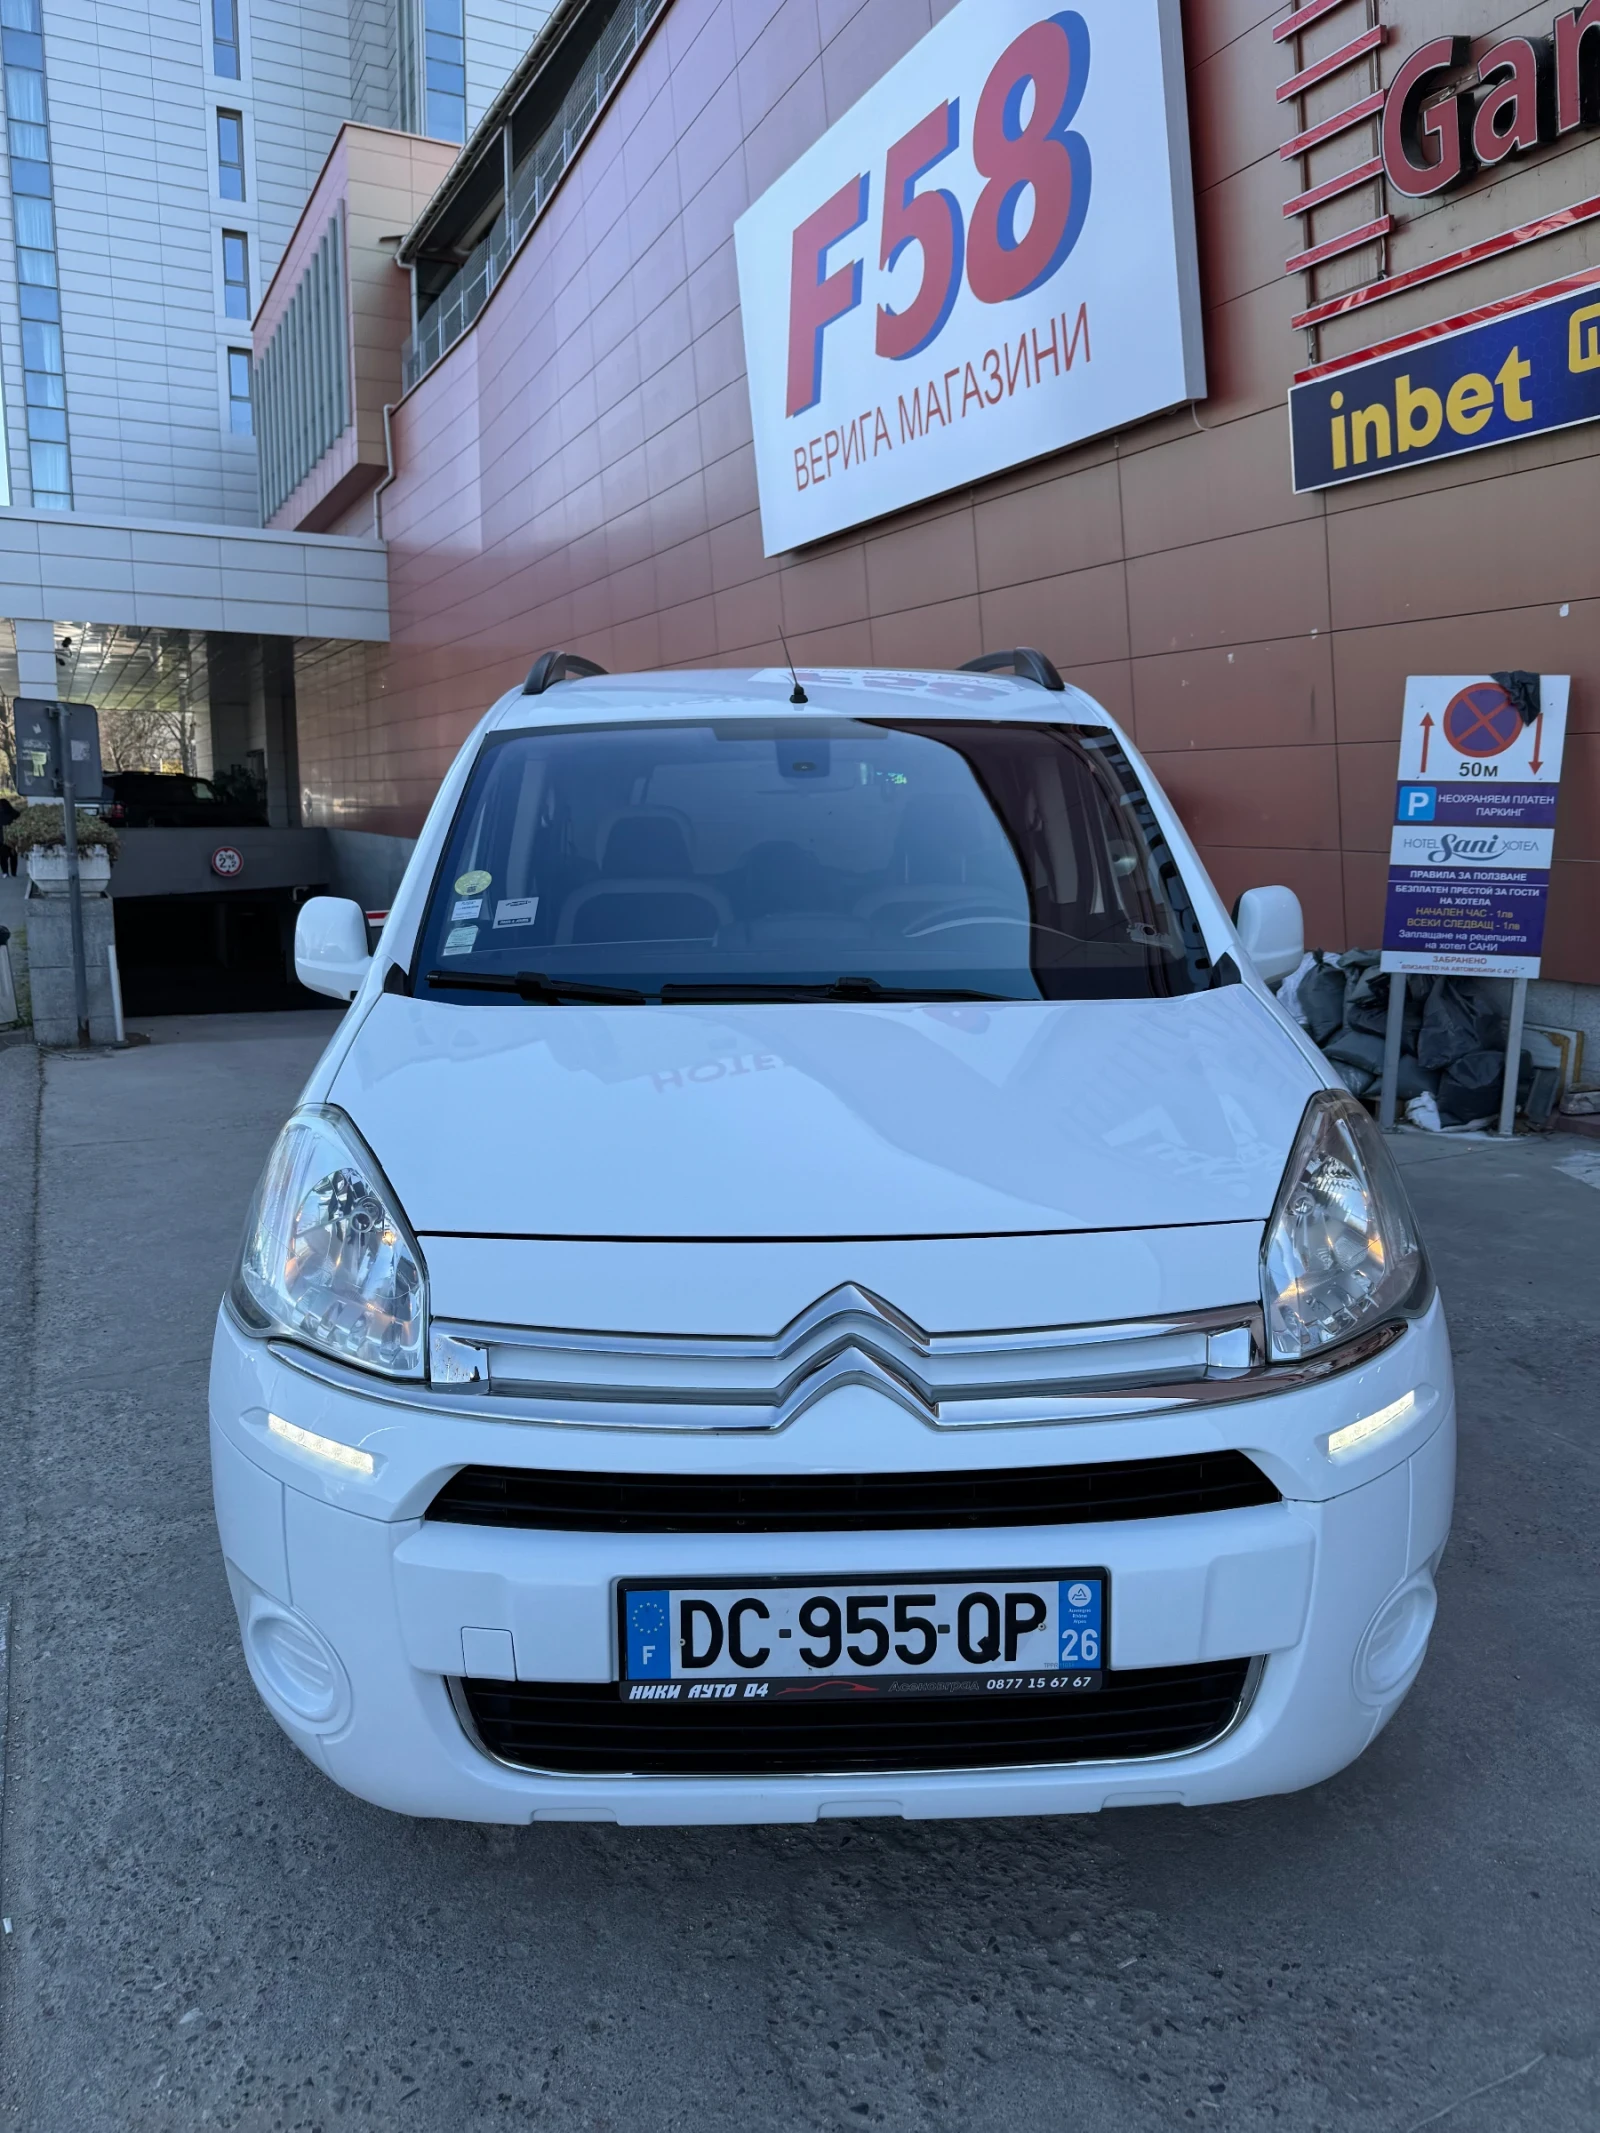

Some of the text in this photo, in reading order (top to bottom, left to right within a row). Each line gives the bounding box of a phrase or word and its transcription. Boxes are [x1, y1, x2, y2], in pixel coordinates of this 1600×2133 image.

[786, 10, 1093, 419] F58
[793, 301, 1093, 493] ВЕРИГА МАГАЗИНИ
[1330, 345, 1533, 471] inbet
[1407, 791, 1430, 817] P
[1437, 794, 1555, 805] НЕОХРАНЯЕМ ПЛАТЕН
[1475, 807, 1525, 817] ПАРКИНГ
[1403, 833, 1507, 863] HOTEL Sani
[1501, 840, 1540, 852] ХОТЕЛ
[1410, 870, 1528, 882] ПРАВИЛА ЗА ПОЛЗВАНЕ
[1395, 884, 1540, 897] БЕЗПЛАТЕН ПРЕСТОЙ ЗА ГОСТИ
[1439, 896, 1492, 906] НА ХОТЕЛА
[1415, 907, 1464, 917] НАЧАЛЕН
[1465, 909, 1488, 918] ЧАС
[1406, 918, 1441, 928] ВСЕКИ
[1443, 919, 1495, 930] СЛЕДВАЩ
[1398, 929, 1527, 944] Заплащане на рецепцията
[1425, 942, 1499, 952] на хотел САНИ
[1432, 955, 1488, 965] ЗАБРАНЕНО
[1061, 1629, 1099, 1662] 26
[641, 1645, 656, 1665] F
[887, 1681, 980, 1693] Асеновград
[986, 1676, 1092, 1690] 0877 15 67 67
[628, 1684, 682, 1700] НИКИ
